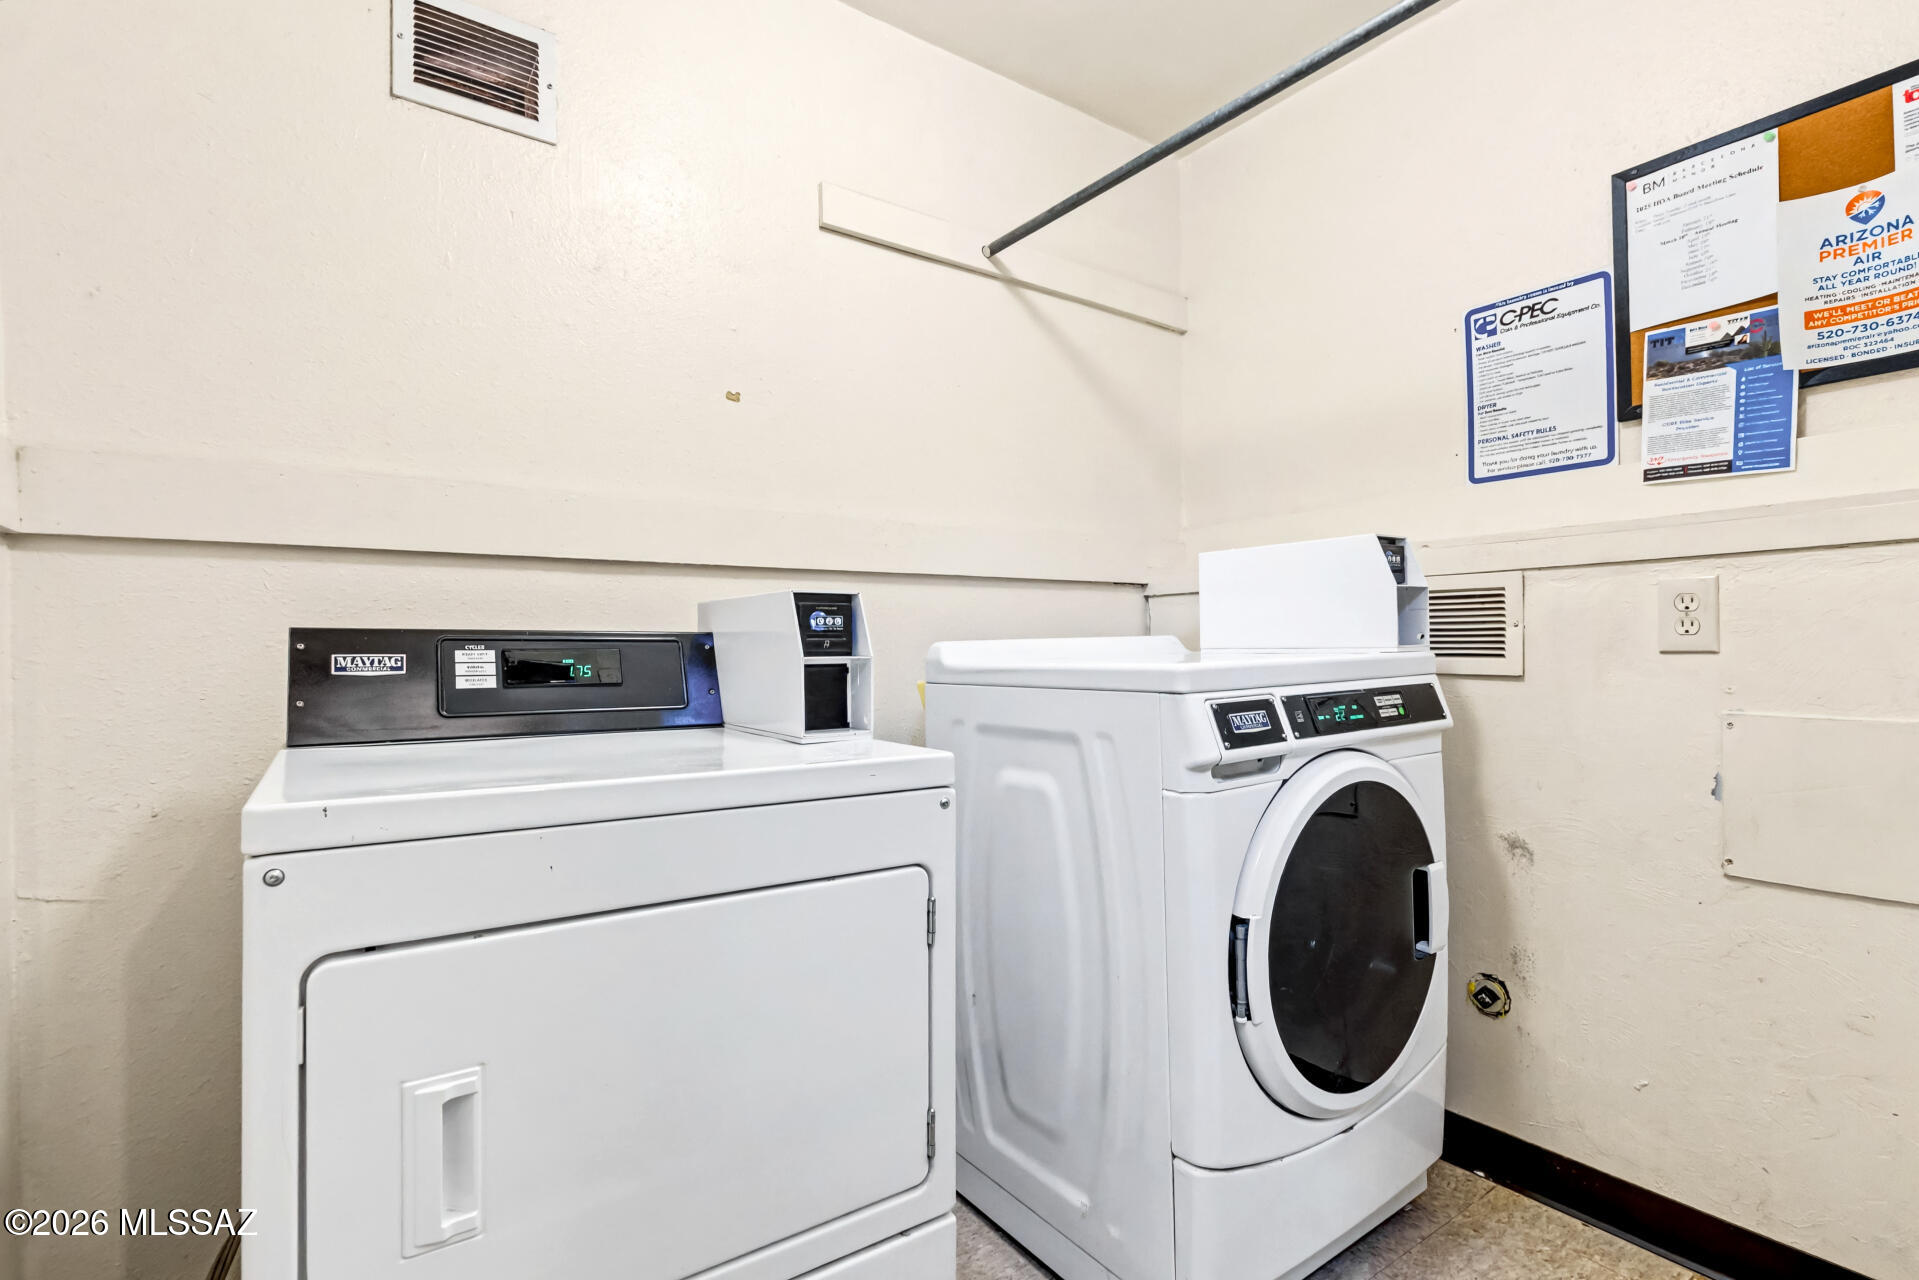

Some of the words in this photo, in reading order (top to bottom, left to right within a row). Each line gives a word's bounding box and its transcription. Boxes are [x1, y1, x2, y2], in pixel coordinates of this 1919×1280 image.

[1642, 176, 1664, 194] BM
[1654, 196, 1670, 206] HOA
[1674, 188, 1694, 199] Board
[1698, 178, 1727, 190] Meeting
[1728, 165, 1764, 180] Schedule
[1820, 215, 1914, 250] ARIZONA
[1820, 228, 1912, 262] PREMIER
[1853, 252, 1882, 266] AIR
[1813, 274, 1838, 284] STAY
[1818, 283, 1837, 291] ALL
[1841, 276, 1870, 287] YEAR
[1874, 262, 1917, 280] ROUND!
[1805, 292, 1836, 302] HEATING
[1842, 284, 1876, 295] COOLING
[1824, 295, 1855, 305] REPAIRS
[1861, 280, 1916, 298] INSTALLATION
[1500, 298, 1559, 326] C-PEC
[1813, 310, 1843, 319] WE'LL
[1846, 302, 1873, 314] MEET
[1876, 298, 1890, 307] OR
[1894, 291, 1918, 302] BEAT
[1520, 315, 1555, 328] Professional
[1556, 305, 1589, 319] Equipment
[1808, 318, 1827, 327] ANY
[1830, 304, 1899, 324] COMPETITOR'S
[1476, 342, 1501, 352] WASHER
[1806, 352, 1845, 365] LICENSED
[1851, 346, 1888, 358] BONDED
[1477, 403, 1497, 411] DRYER
[1478, 434, 1509, 444] PERSONAL
[1511, 430, 1534, 439] SAFETY
[1536, 426, 1557, 434] RULES
[336, 656, 402, 667] MAYTAG
[1232, 713, 1266, 726] MAYTAG
